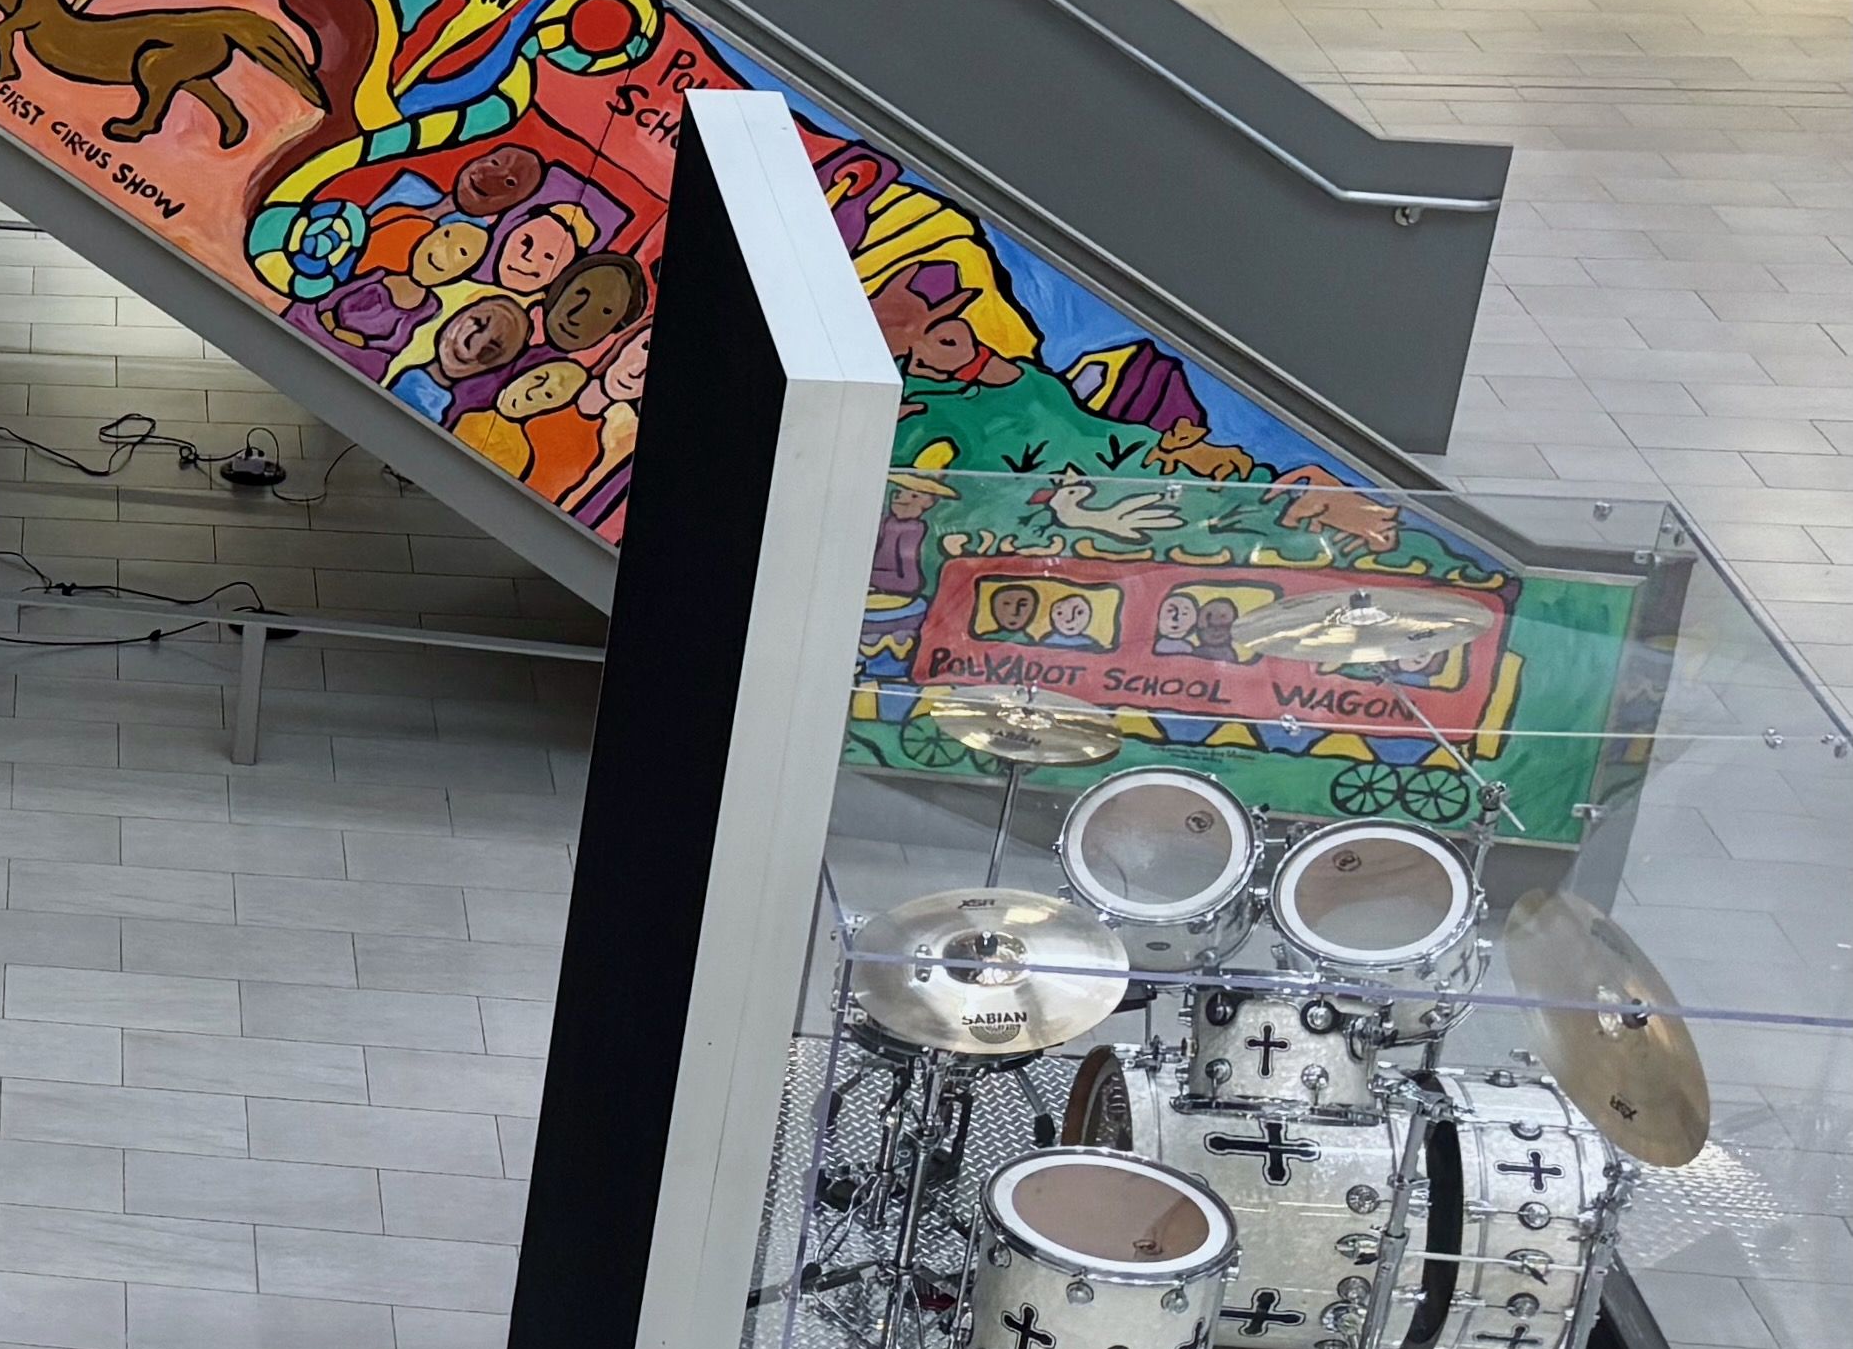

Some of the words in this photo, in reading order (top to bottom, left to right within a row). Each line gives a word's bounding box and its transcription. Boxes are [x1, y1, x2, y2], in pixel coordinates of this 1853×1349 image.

[50, 119, 113, 170] CIRCUS
[111, 161, 187, 220] SHOW
[928, 646, 1087, 687] POLKADOT
[1102, 667, 1233, 707] SCHOOL
[1270, 679, 1419, 724] WAGON
[962, 1011, 1028, 1025] SABIAN
